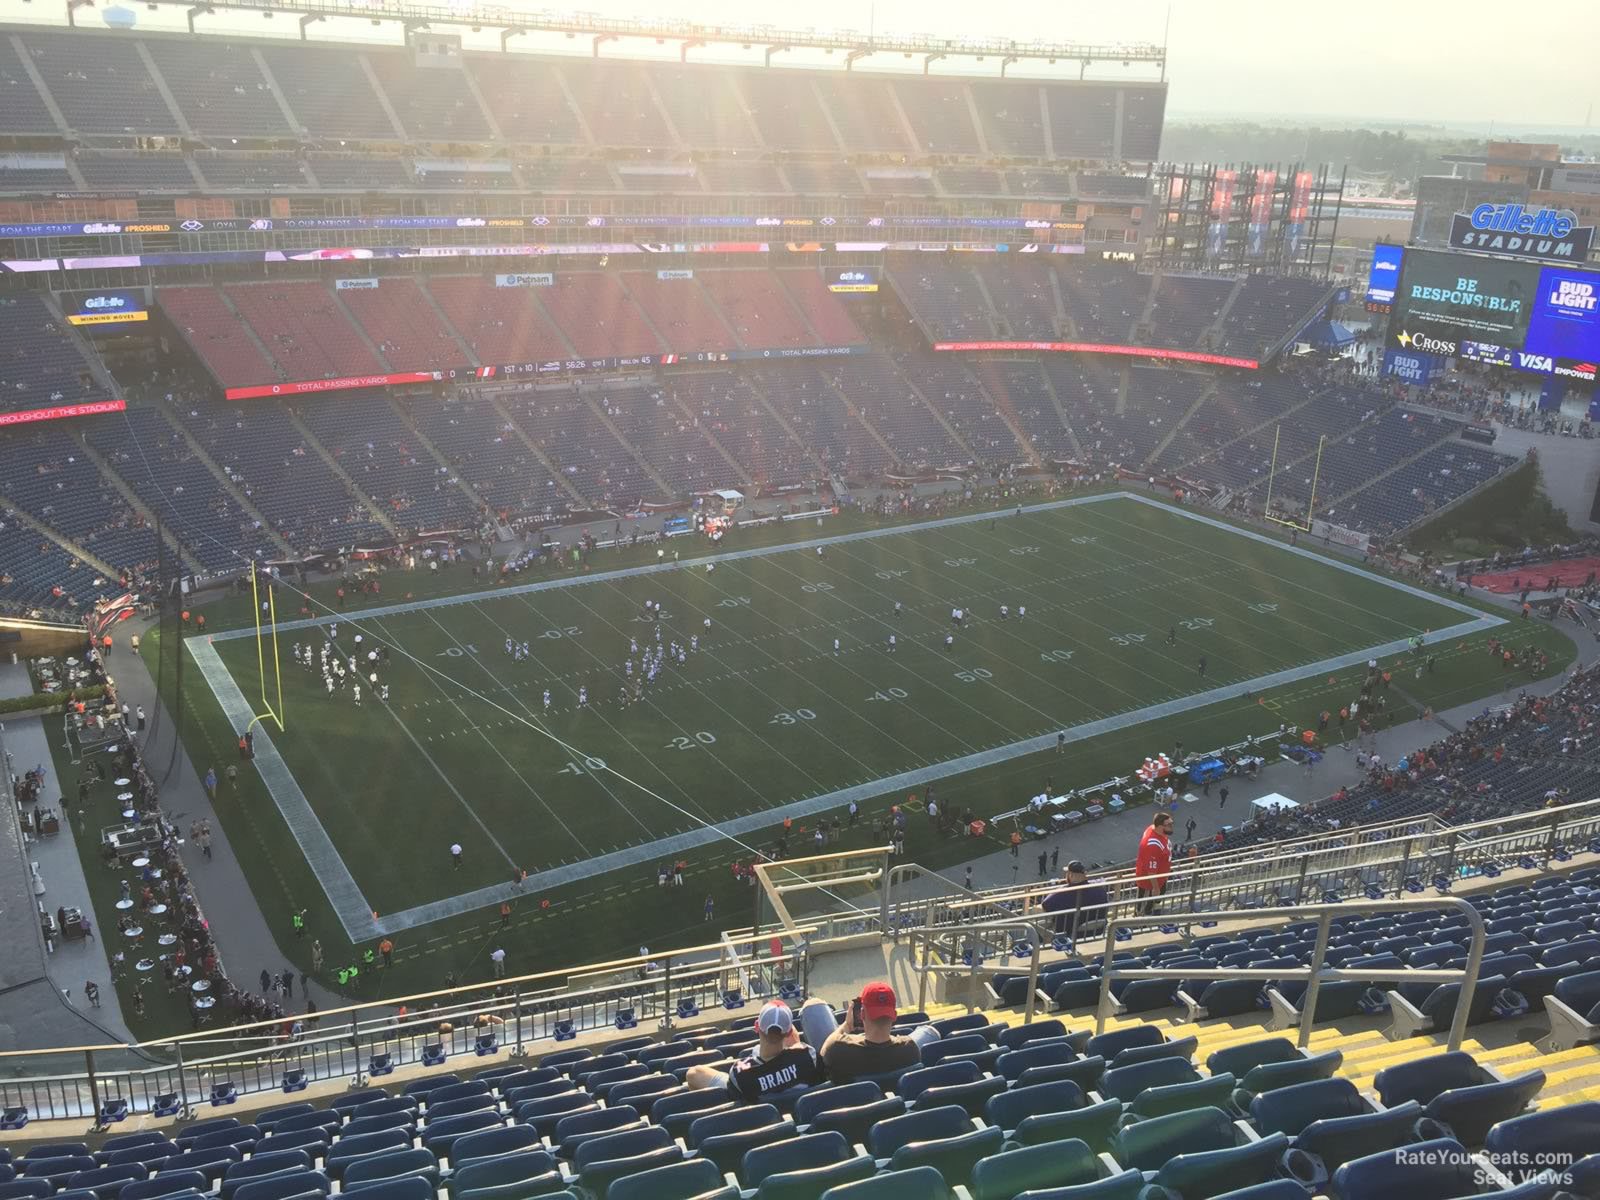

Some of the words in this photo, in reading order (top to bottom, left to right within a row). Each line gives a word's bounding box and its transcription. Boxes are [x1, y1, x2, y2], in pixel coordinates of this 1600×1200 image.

[456, 217, 486, 227] Gillette
[1471, 203, 1573, 239] Gillette
[0, 227, 22, 235] ROM
[26, 226, 42, 234] THE
[46, 225, 73, 233] START
[83, 223, 122, 234] Gillette
[125, 224, 170, 233] #PROSHIELD
[1462, 232, 1574, 256] STADIUM
[516, 275, 550, 284] Putnam
[1456, 278, 1478, 293] BE
[1559, 281, 1593, 297] BUD
[85, 296, 125, 308] Gillette
[1550, 291, 1597, 309] LIGHT
[1031, 342, 1051, 350] FREE
[641, 356, 651, 364] 45
[698, 353, 703, 361] 0
[1393, 356, 1420, 369] BUD
[1518, 352, 1553, 372] VISA
[449, 370, 455, 378] 0
[504, 365, 515, 373] 1ST
[525, 364, 533, 373] 10
[1554, 366, 1596, 381] EMPOWER
[272, 385, 280, 393] 0
[296, 383, 321, 392] TOTAL
[324, 380, 359, 389] PASSING
[361, 377, 388, 386] YARDS
[59, 407, 77, 416] THE
[79, 403, 118, 414] STADIUM
[954, 668, 993, 683] 50
[874, 687, 909, 702] 40
[774, 708, 817, 725] 30
[672, 731, 717, 751] 20
[566, 757, 607, 776] 10
[1149, 860, 1158, 869] 12
[758, 1064, 798, 1092] BRADY
